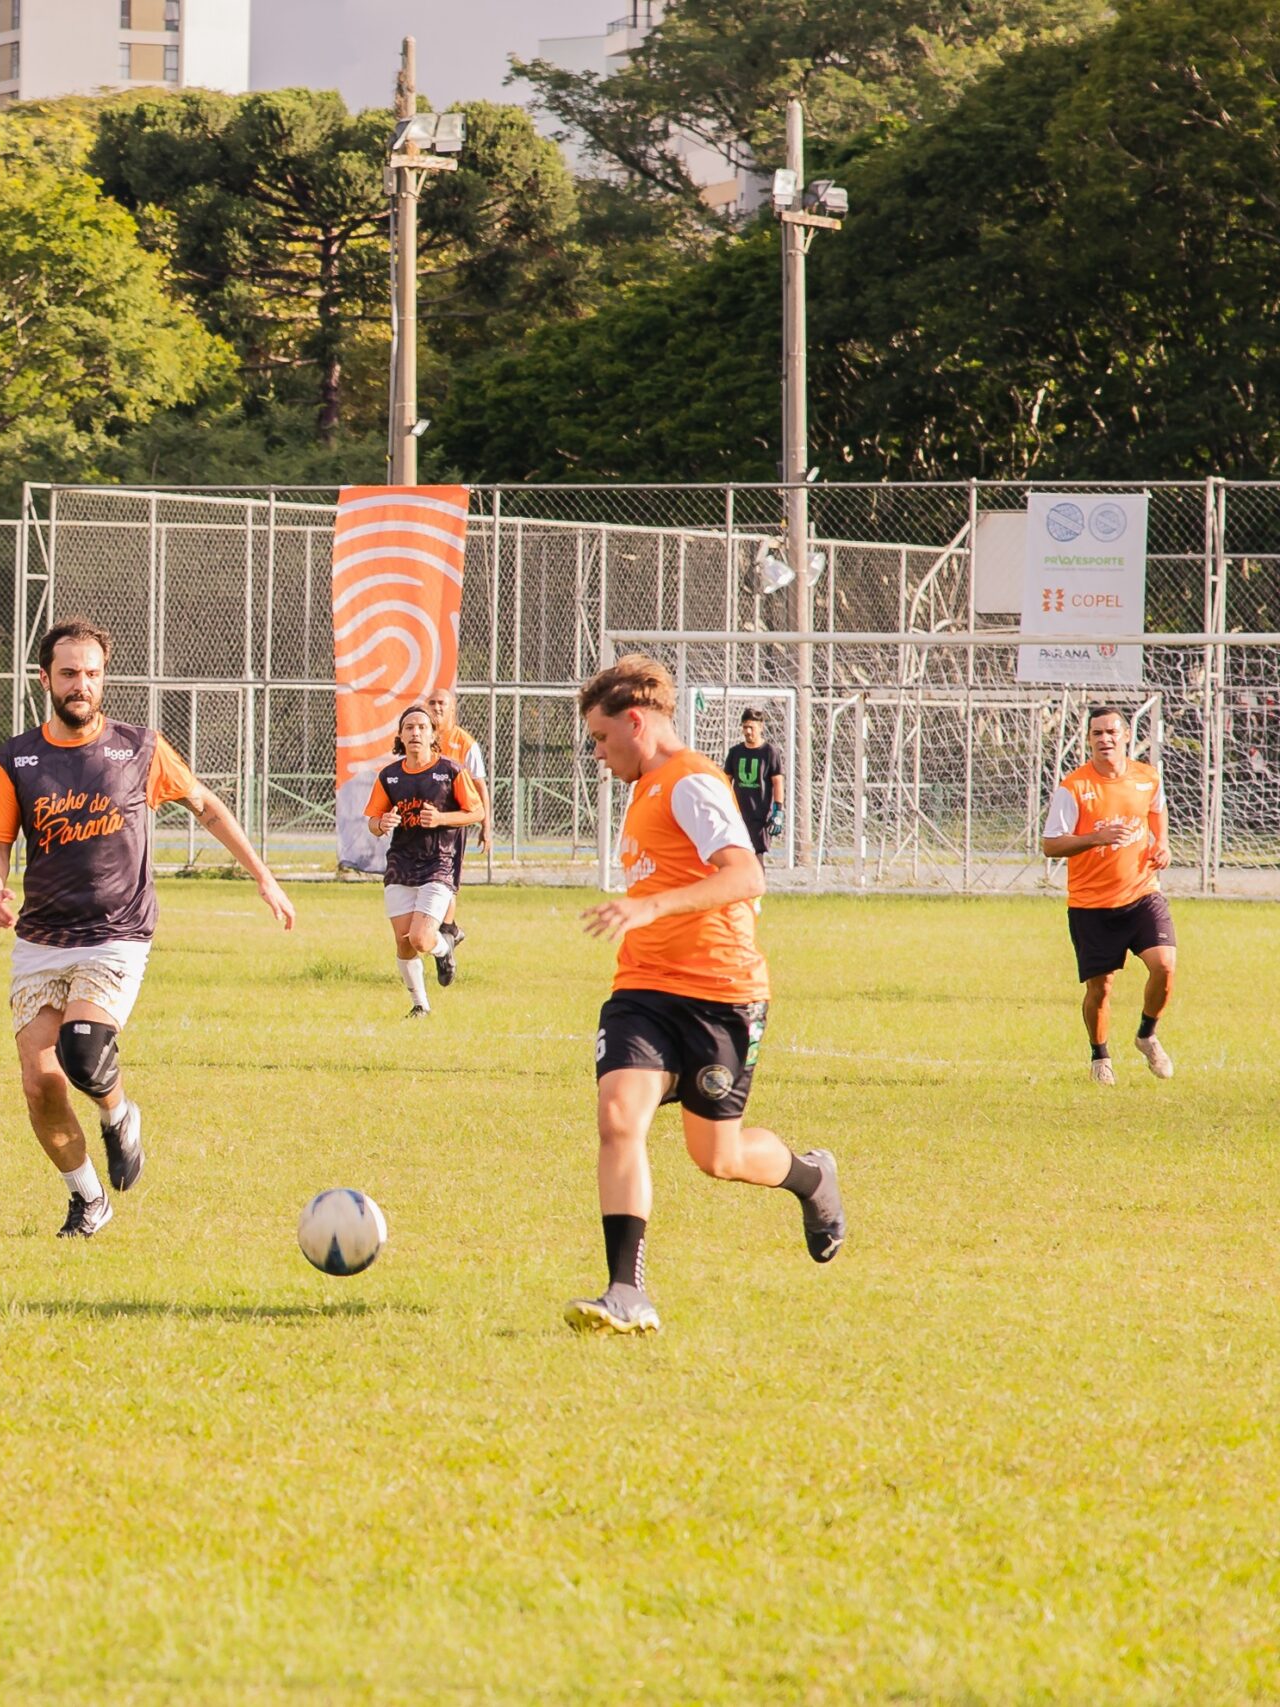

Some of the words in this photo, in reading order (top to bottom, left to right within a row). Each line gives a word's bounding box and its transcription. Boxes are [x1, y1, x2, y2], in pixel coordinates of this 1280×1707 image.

[1071, 594, 1124, 608] COPEL
[14, 755, 39, 768] RPC
[34, 789, 88, 830] Bicho
[89, 792, 111, 813] do
[39, 806, 124, 854] Paraná
